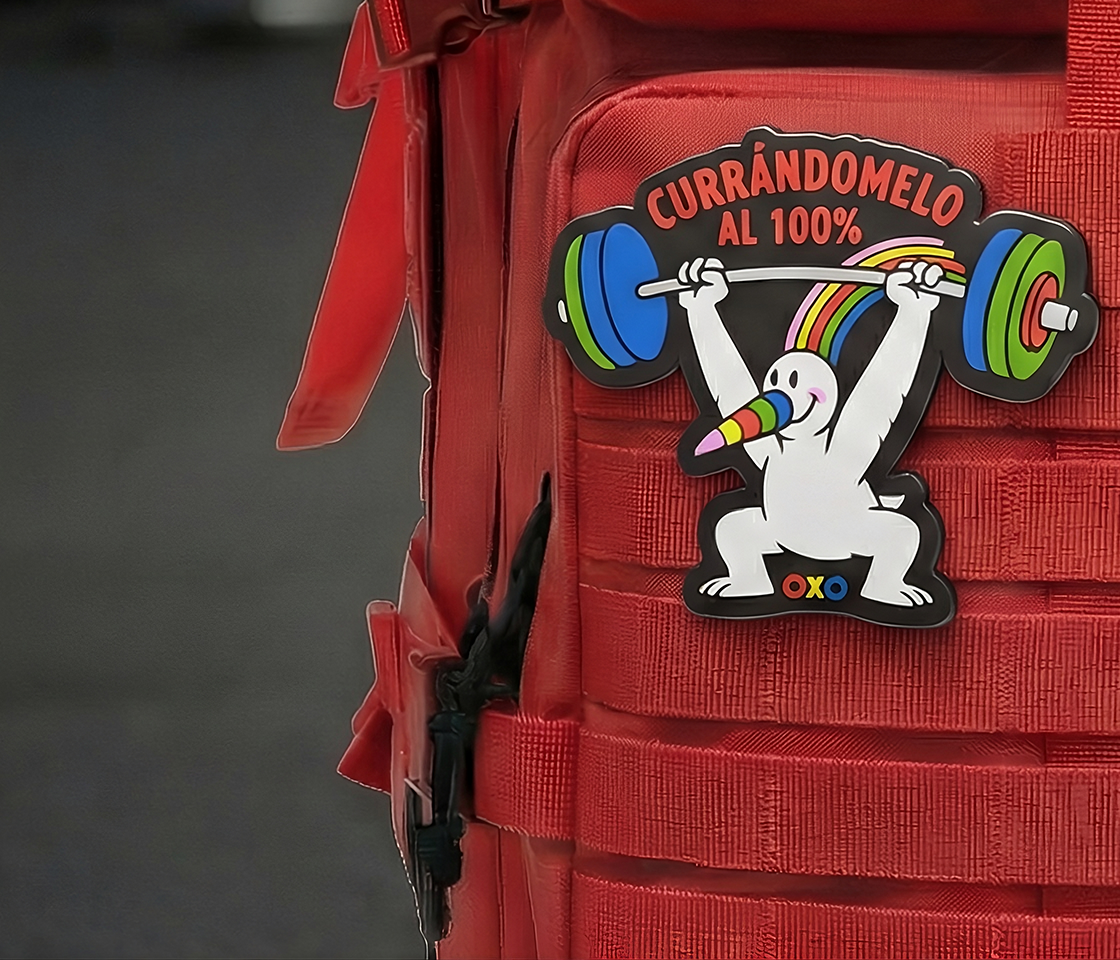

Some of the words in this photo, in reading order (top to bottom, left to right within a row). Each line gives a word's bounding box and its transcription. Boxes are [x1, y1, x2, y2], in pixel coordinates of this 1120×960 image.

[646, 141, 965, 230] CURRÁNDOMELO
[717, 210, 758, 246] AL
[770, 206, 863, 246] 100%
[782, 573, 848, 601] OXO
